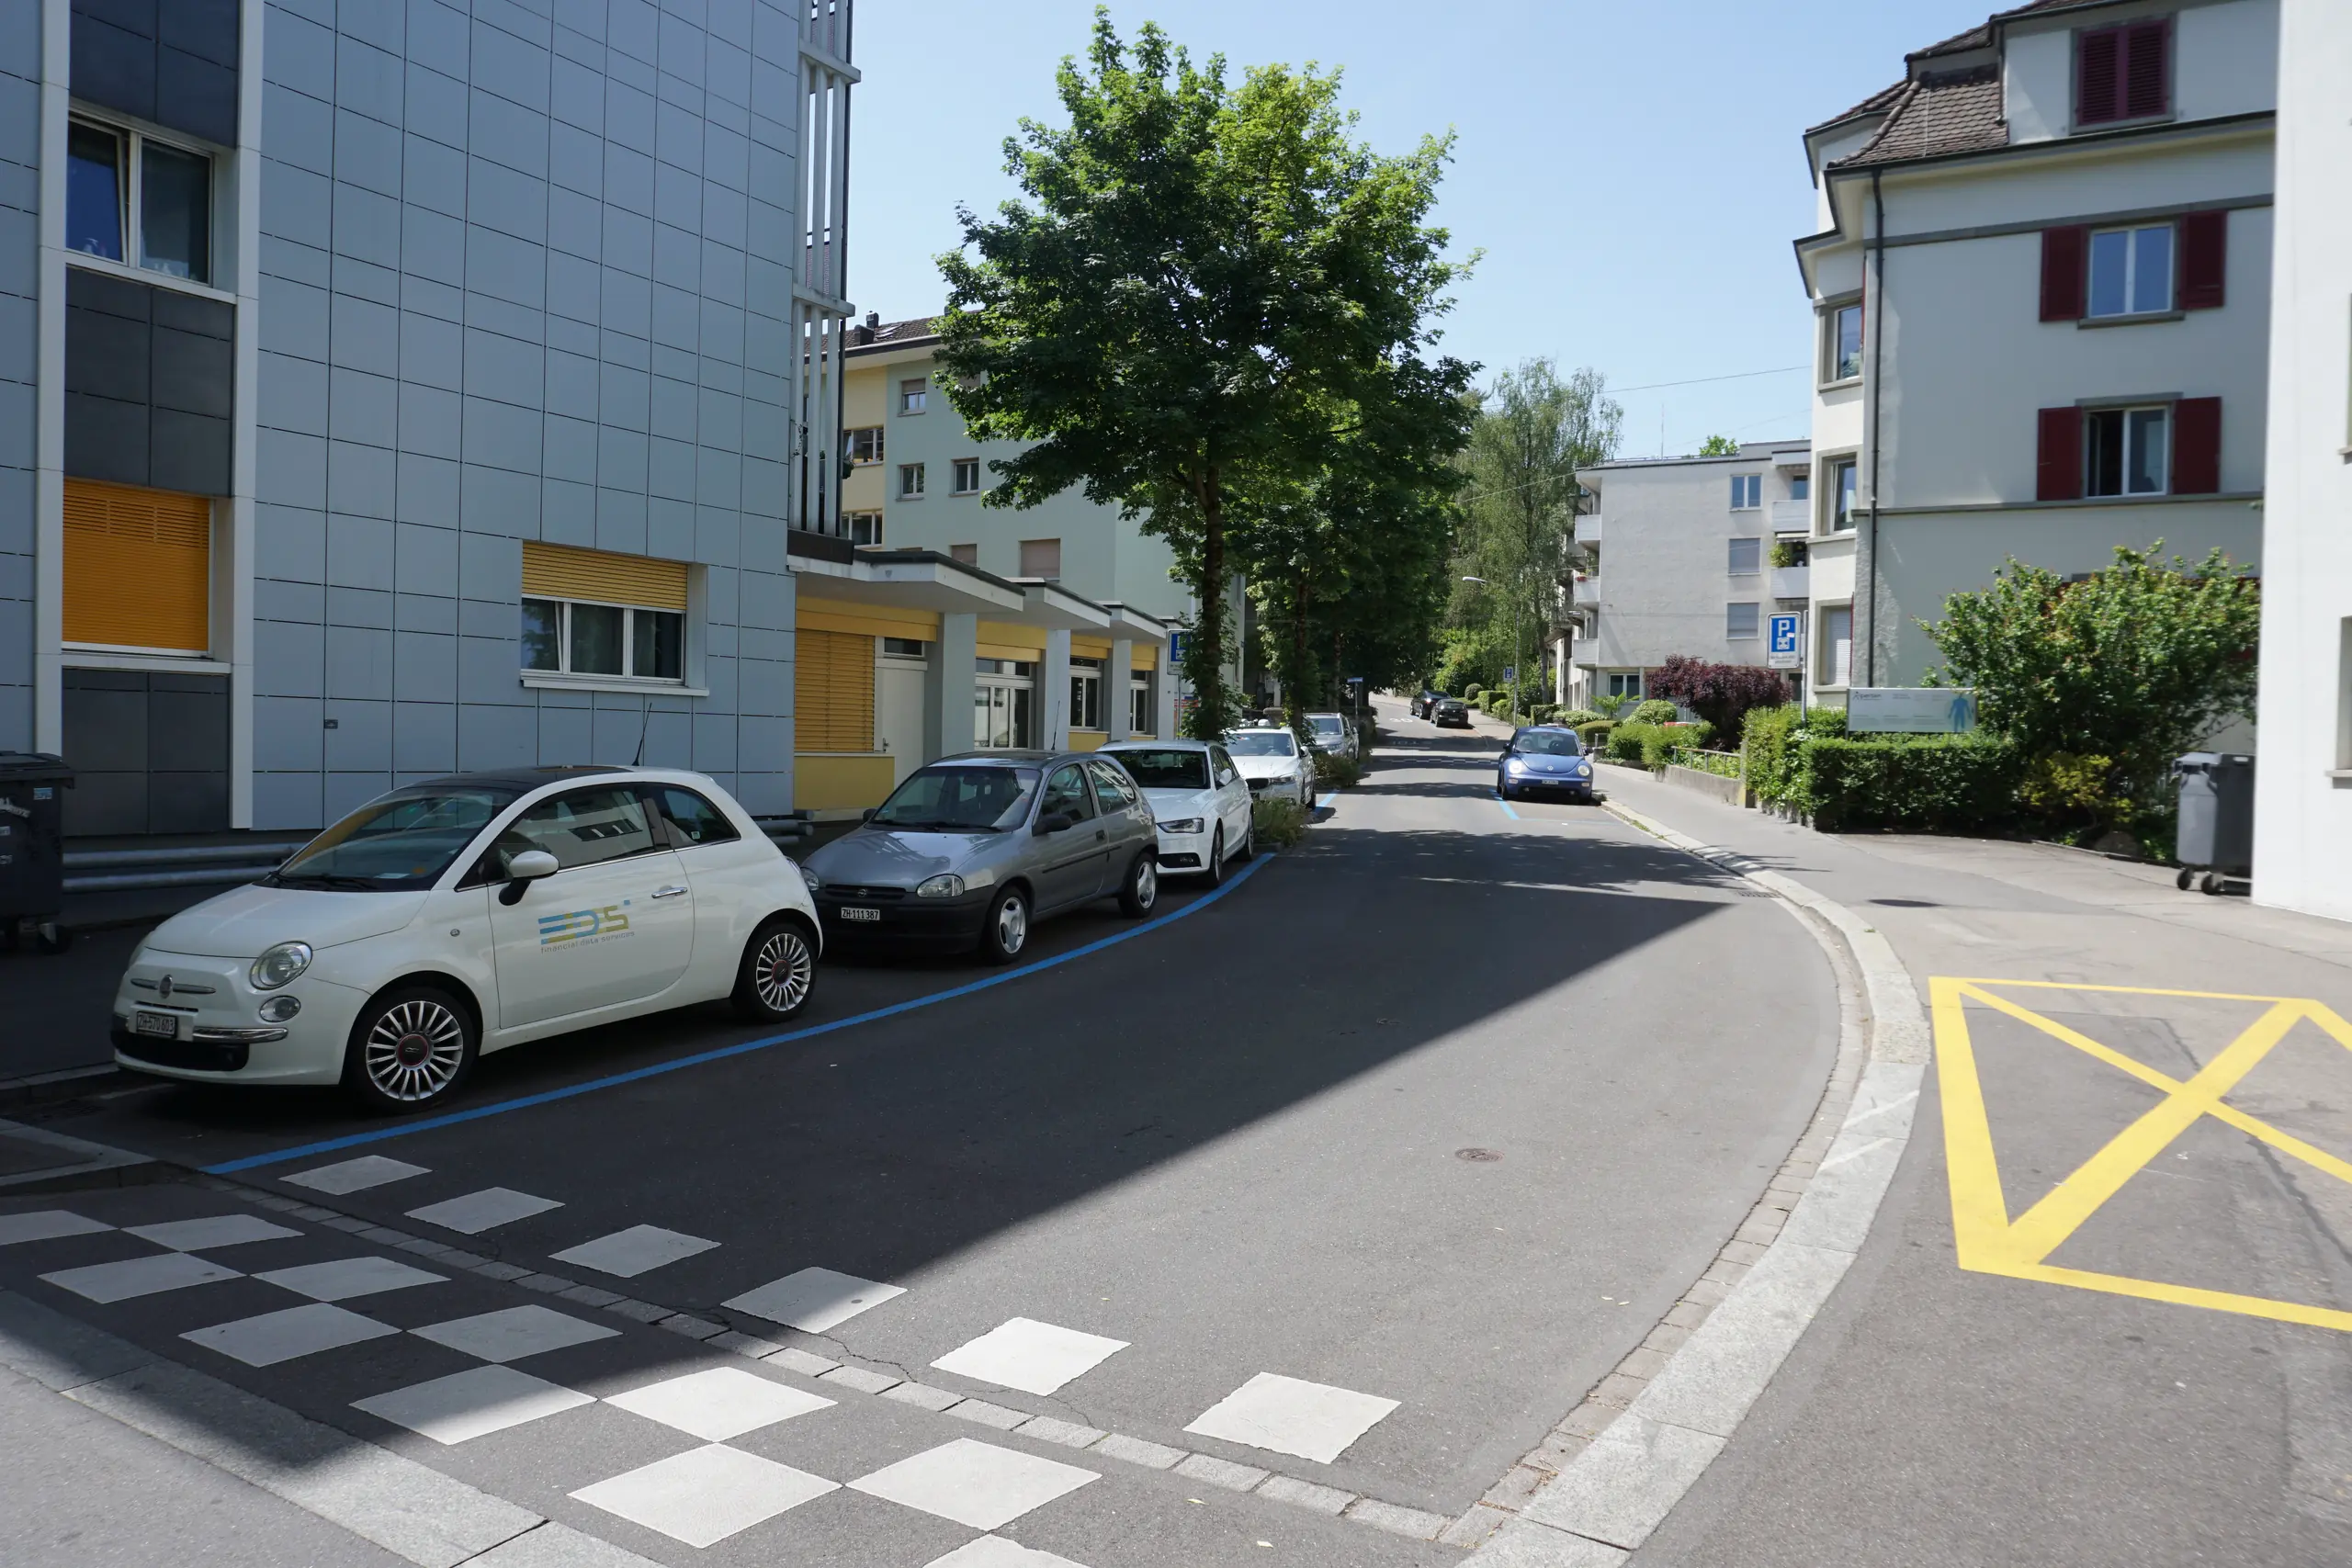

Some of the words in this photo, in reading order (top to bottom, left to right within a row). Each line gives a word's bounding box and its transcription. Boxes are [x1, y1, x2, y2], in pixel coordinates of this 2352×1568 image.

[1778, 619, 1791, 637] P
[540, 940, 578, 953] financial
[580, 937, 599, 946] data
[601, 931, 635, 942] services
